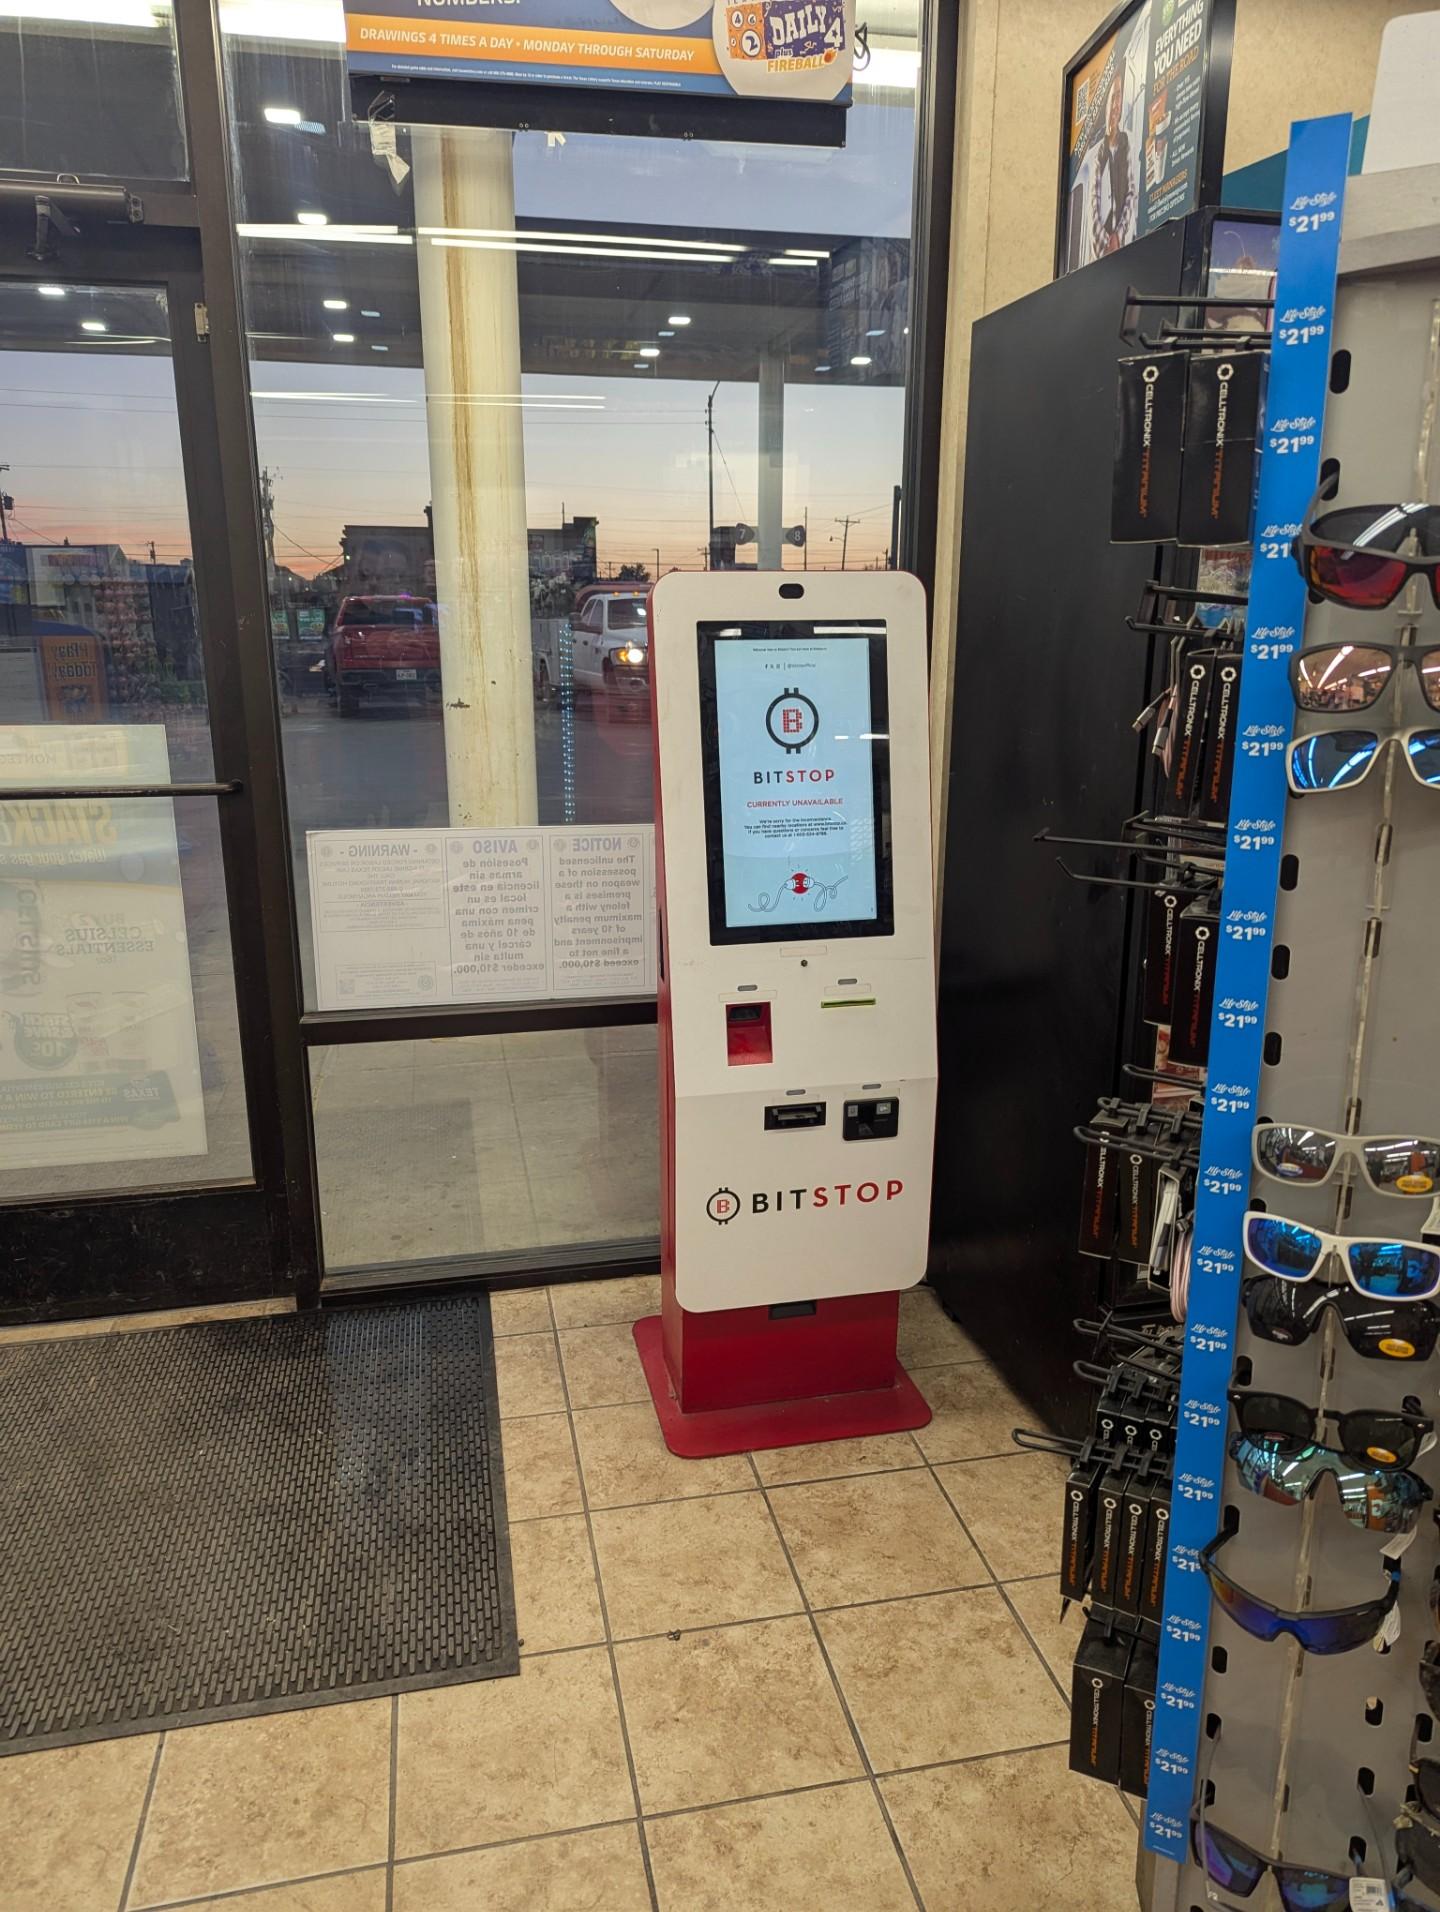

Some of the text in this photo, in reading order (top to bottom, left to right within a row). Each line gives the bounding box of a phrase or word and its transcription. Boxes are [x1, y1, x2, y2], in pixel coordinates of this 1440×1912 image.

[360, 28, 694, 61] DRAWINGS 4 TIMES A DAY MONDAY THROUGH SATURDAY
[770, 5, 826, 45] DAILY
[824, 18, 842, 47] 4
[1156, 0, 1204, 56] EVERYTHING
[768, 55, 825, 72] FIREBALL
[775, 47, 793, 58] plus
[1154, 19, 1202, 79] YOU NEED
[1143, 384, 1153, 447] CELLTRONIX
[1216, 382, 1228, 447] CELLTRONIX
[1184, 681, 1199, 736] CELLTRONIX
[1218, 683, 1230, 739] CELLTRONIX
[754, 769, 835, 784] BITSTOP
[1194, 941, 1204, 991] CELLTRONIX
[752, 1180, 903, 1213] BITSTOP
[1104, 1509, 1112, 1548] CELLTRONIX
[1128, 1516, 1138, 1554] CELLTRONIX
[1155, 1520, 1164, 1561] CELLTRONIX
